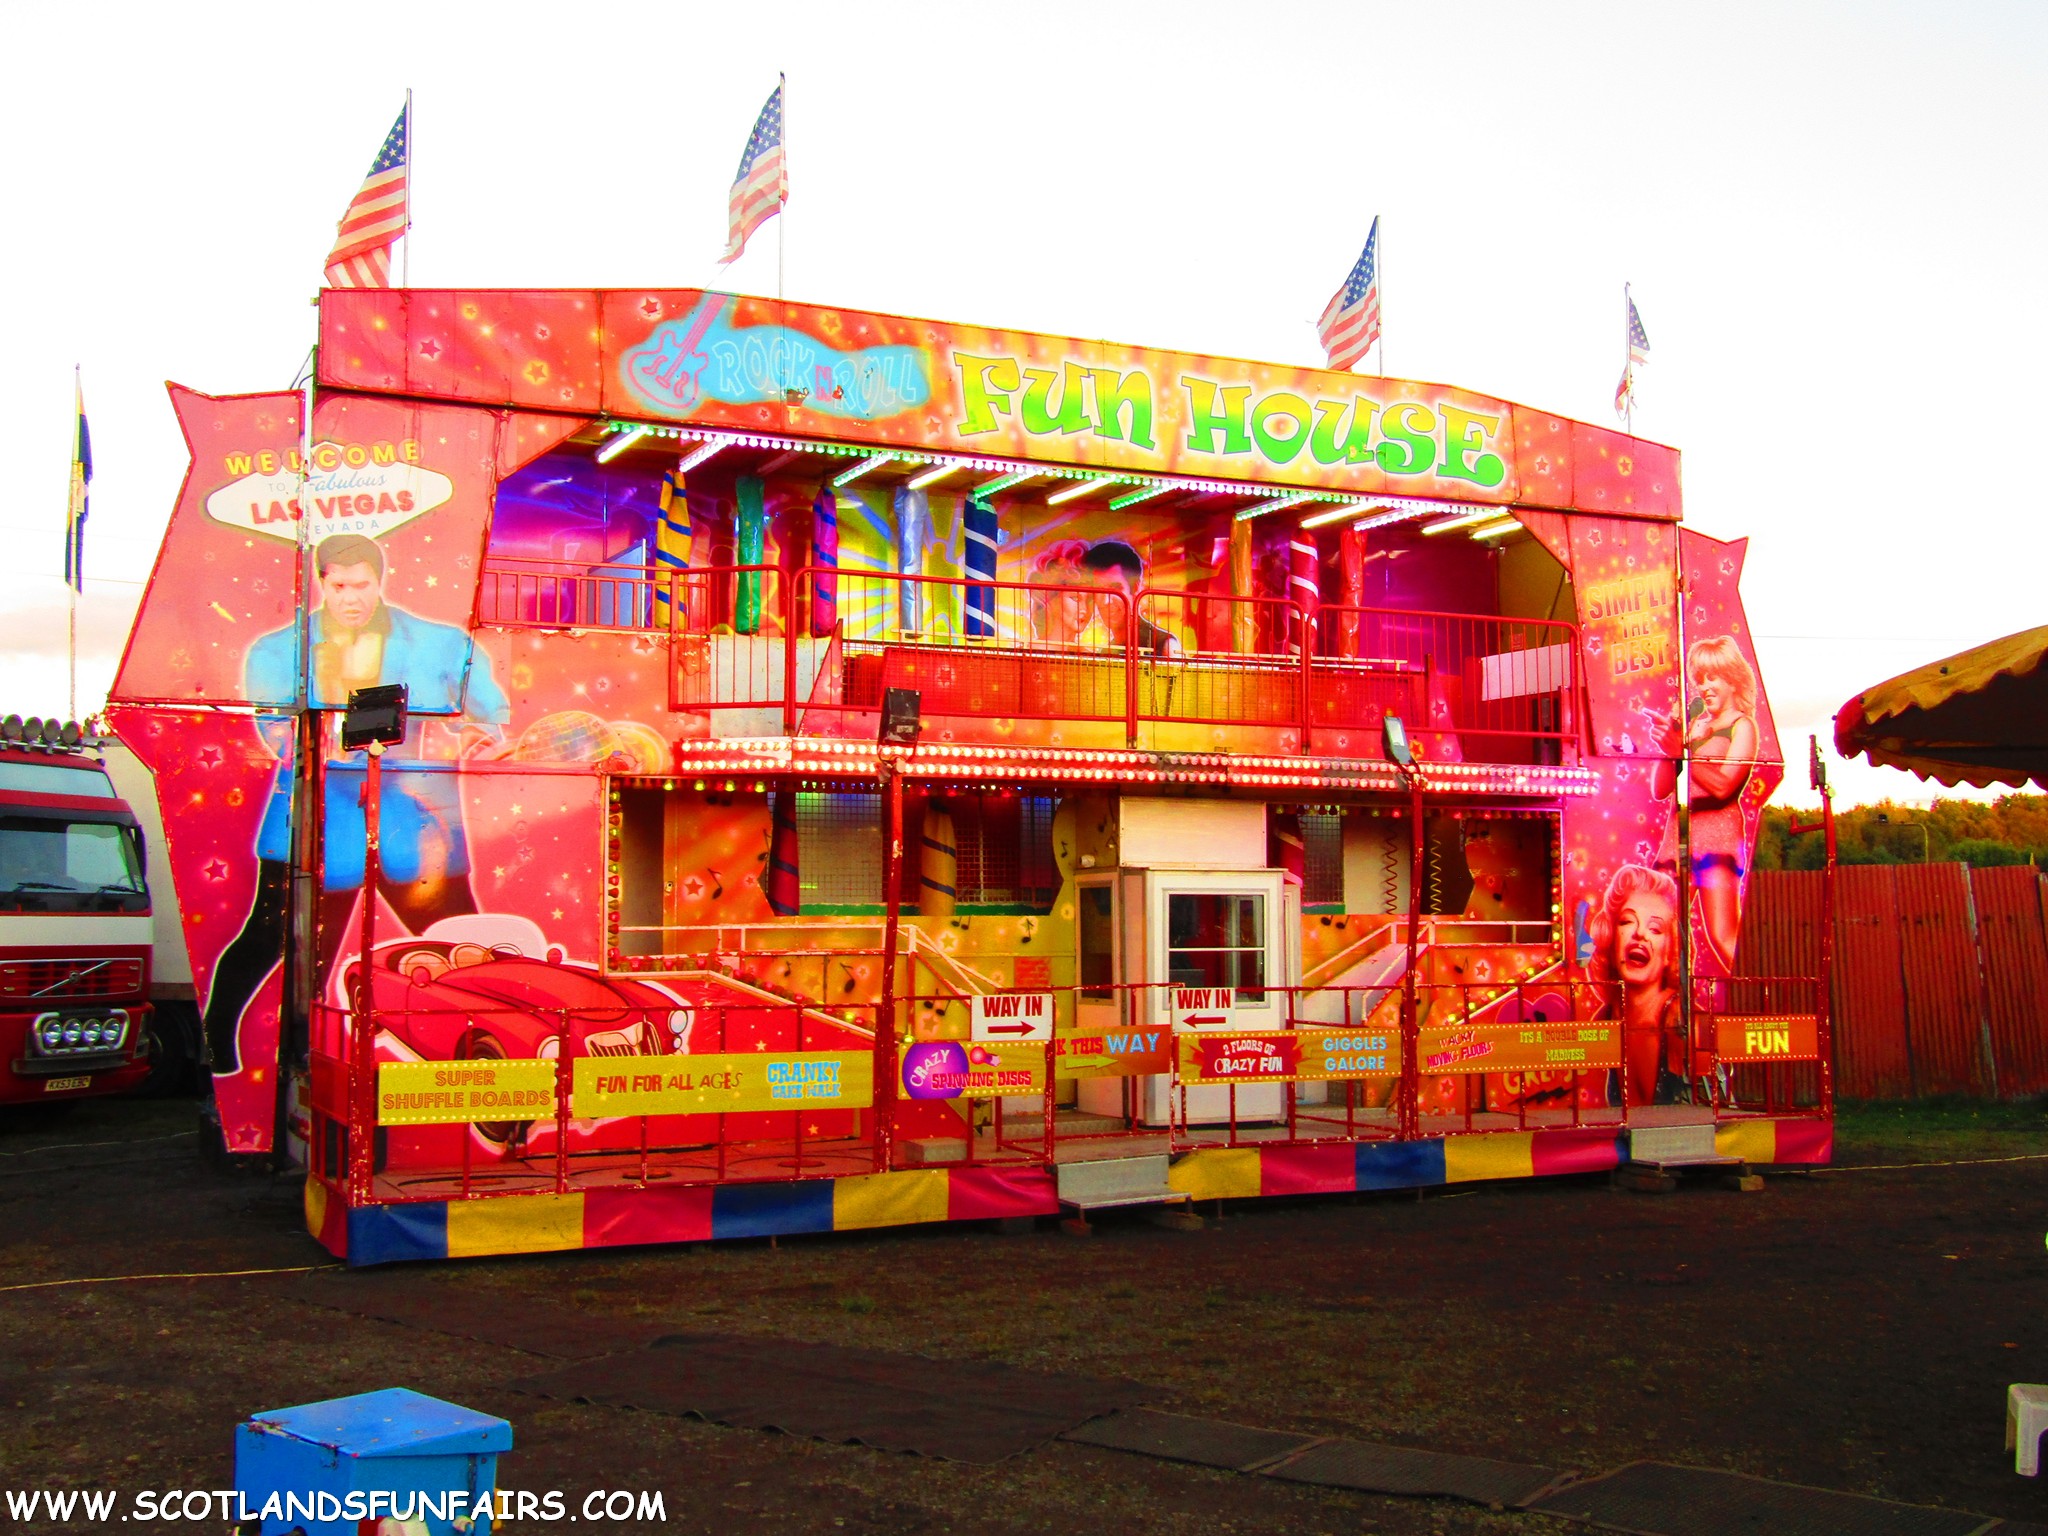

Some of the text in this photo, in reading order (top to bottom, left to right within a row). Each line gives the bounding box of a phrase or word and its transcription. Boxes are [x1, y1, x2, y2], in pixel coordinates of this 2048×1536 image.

[712, 335, 916, 414] ROCK N ROLL
[1181, 376, 1505, 487] HOUSE
[225, 441, 419, 475] WELCOME
[268, 483, 285, 492] TO
[251, 490, 415, 524] LAS VEGAS
[315, 520, 379, 534] EVADA
[1586, 573, 1669, 620] SIMPLY
[1619, 612, 1650, 639] THE
[1611, 634, 1667, 676] BEST
[983, 996, 1042, 1017] WAY IN
[1177, 988, 1231, 1009] WAY IN
[1071, 1036, 1103, 1055] THIS
[1106, 1032, 1160, 1054] WAY
[1323, 1036, 1387, 1052] GIGGLES
[1439, 1030, 1475, 1048] WACKY
[1520, 1031, 1534, 1043] ITS
[1536, 1031, 1543, 1043] A
[1577, 1029, 1597, 1042] DOSE
[1599, 1029, 1609, 1041] OF
[1745, 1031, 1789, 1054] FUN
[1223, 1040, 1276, 1056] 2 FLOORS OF
[1427, 1041, 1494, 1068] MOVING FLOORS
[1546, 1048, 1585, 1061] MADNESS
[767, 1062, 841, 1083] CRANKY
[910, 1049, 950, 1087] CRAZY
[1214, 1057, 1283, 1074] CRAZY FUN
[1325, 1056, 1386, 1071] GALORE
[435, 1070, 495, 1086] SUPER
[596, 1072, 743, 1094] FUN FOR ALL AGES
[931, 1071, 1032, 1089] SPINNING DISCS
[383, 1090, 551, 1110] SHUFFLE BOARDS
